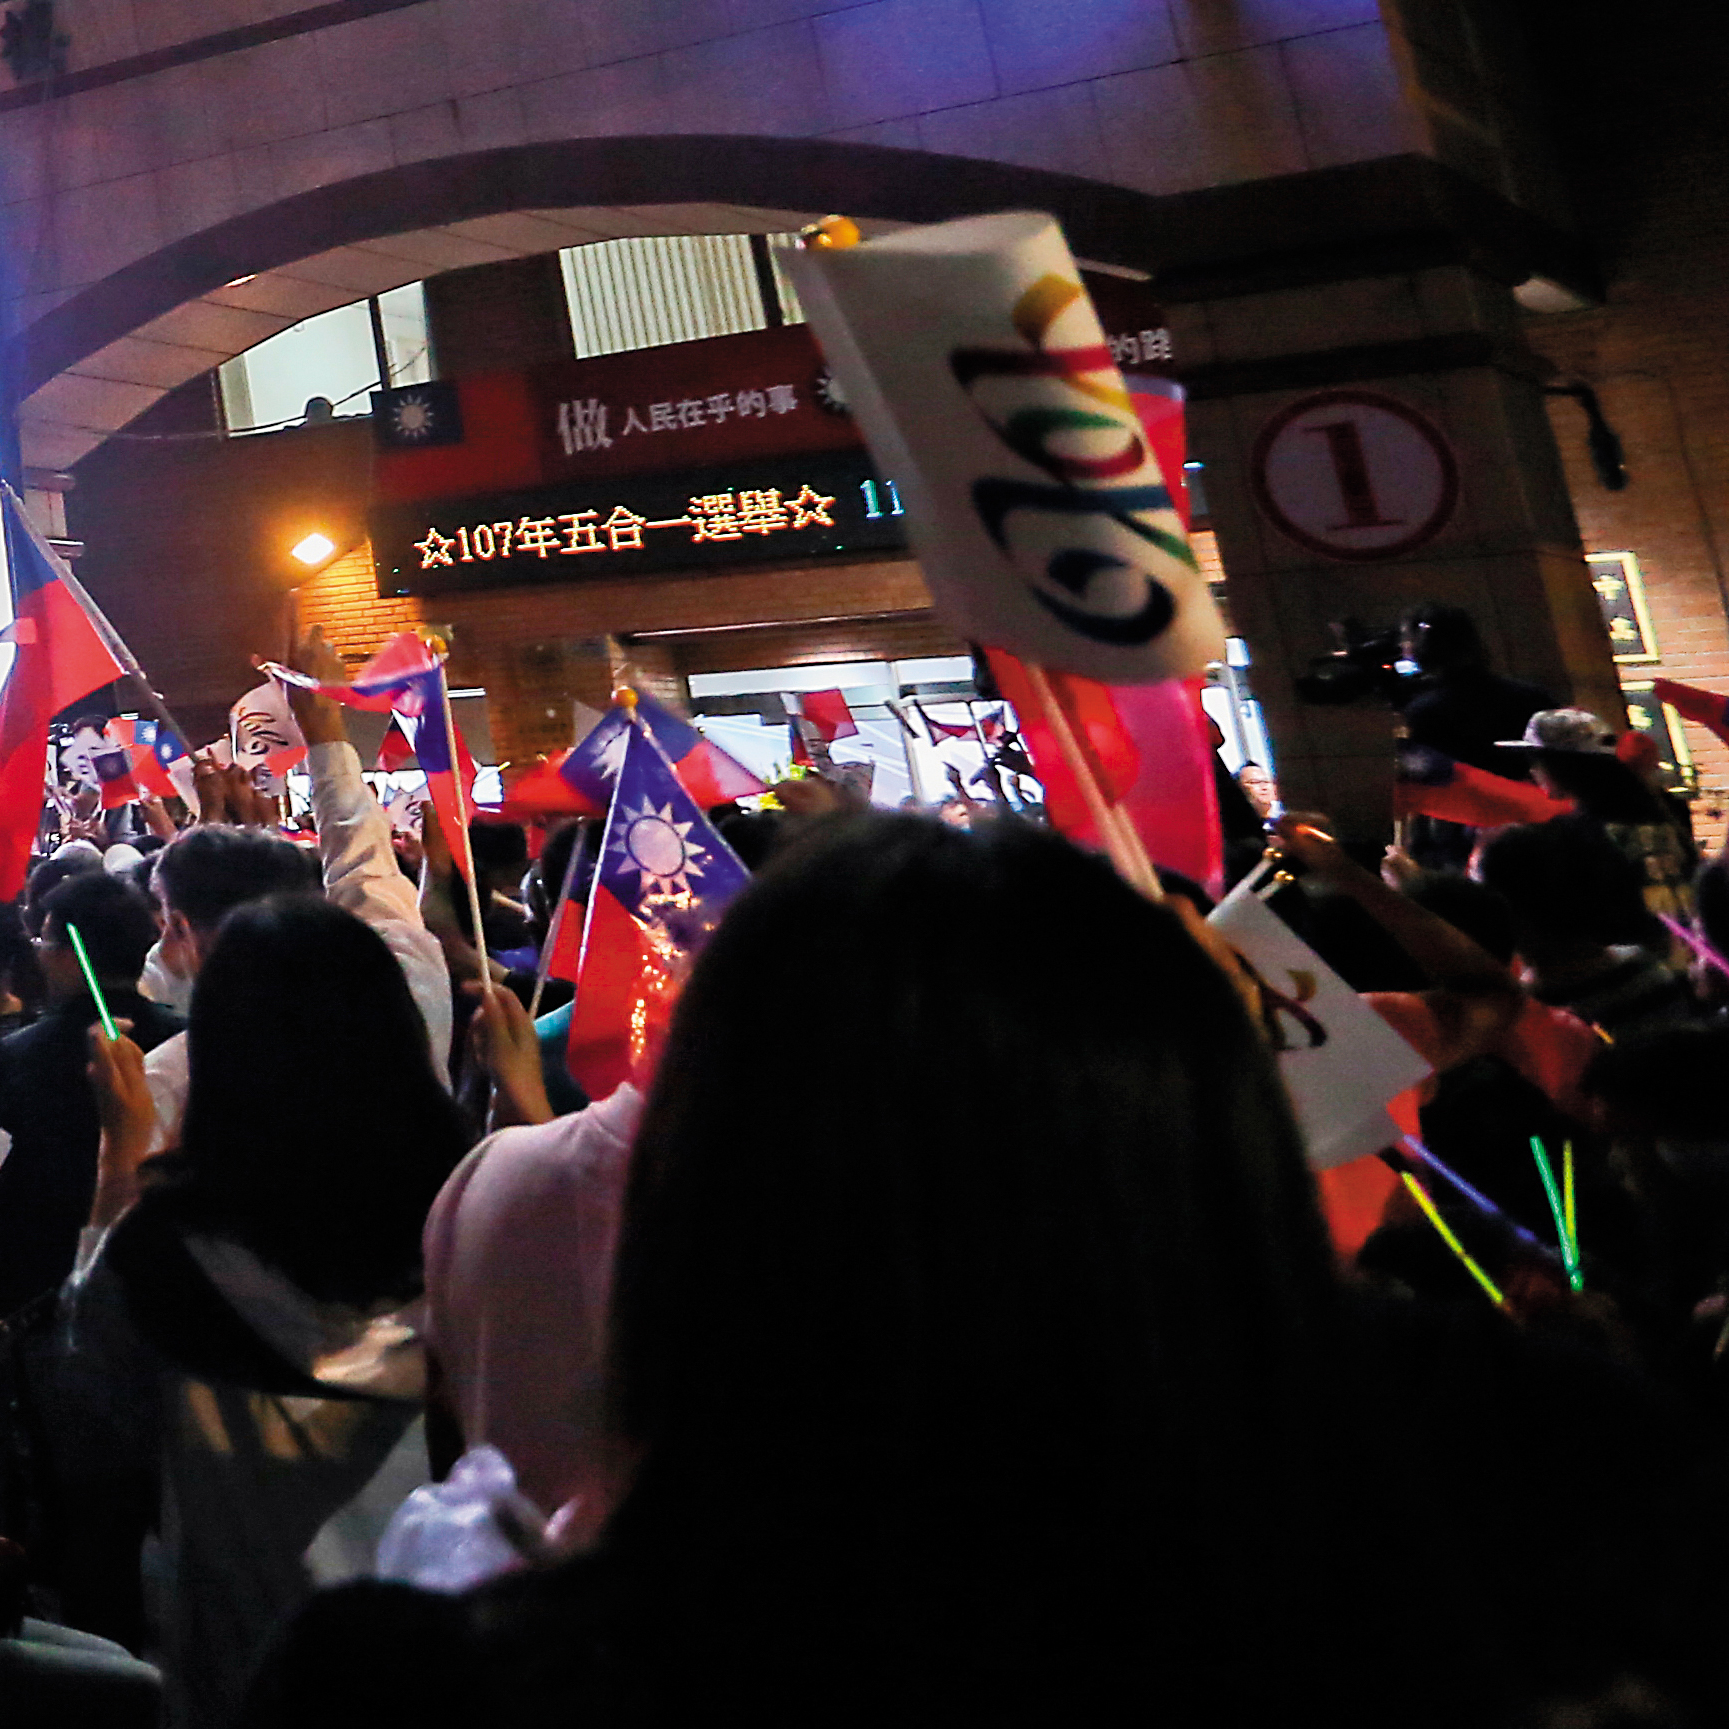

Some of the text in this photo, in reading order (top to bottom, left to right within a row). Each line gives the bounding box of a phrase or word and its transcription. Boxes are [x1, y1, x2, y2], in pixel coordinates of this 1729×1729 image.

[557, 384, 799, 455] 做 人民在乎的事
[1302, 420, 1410, 534] 1
